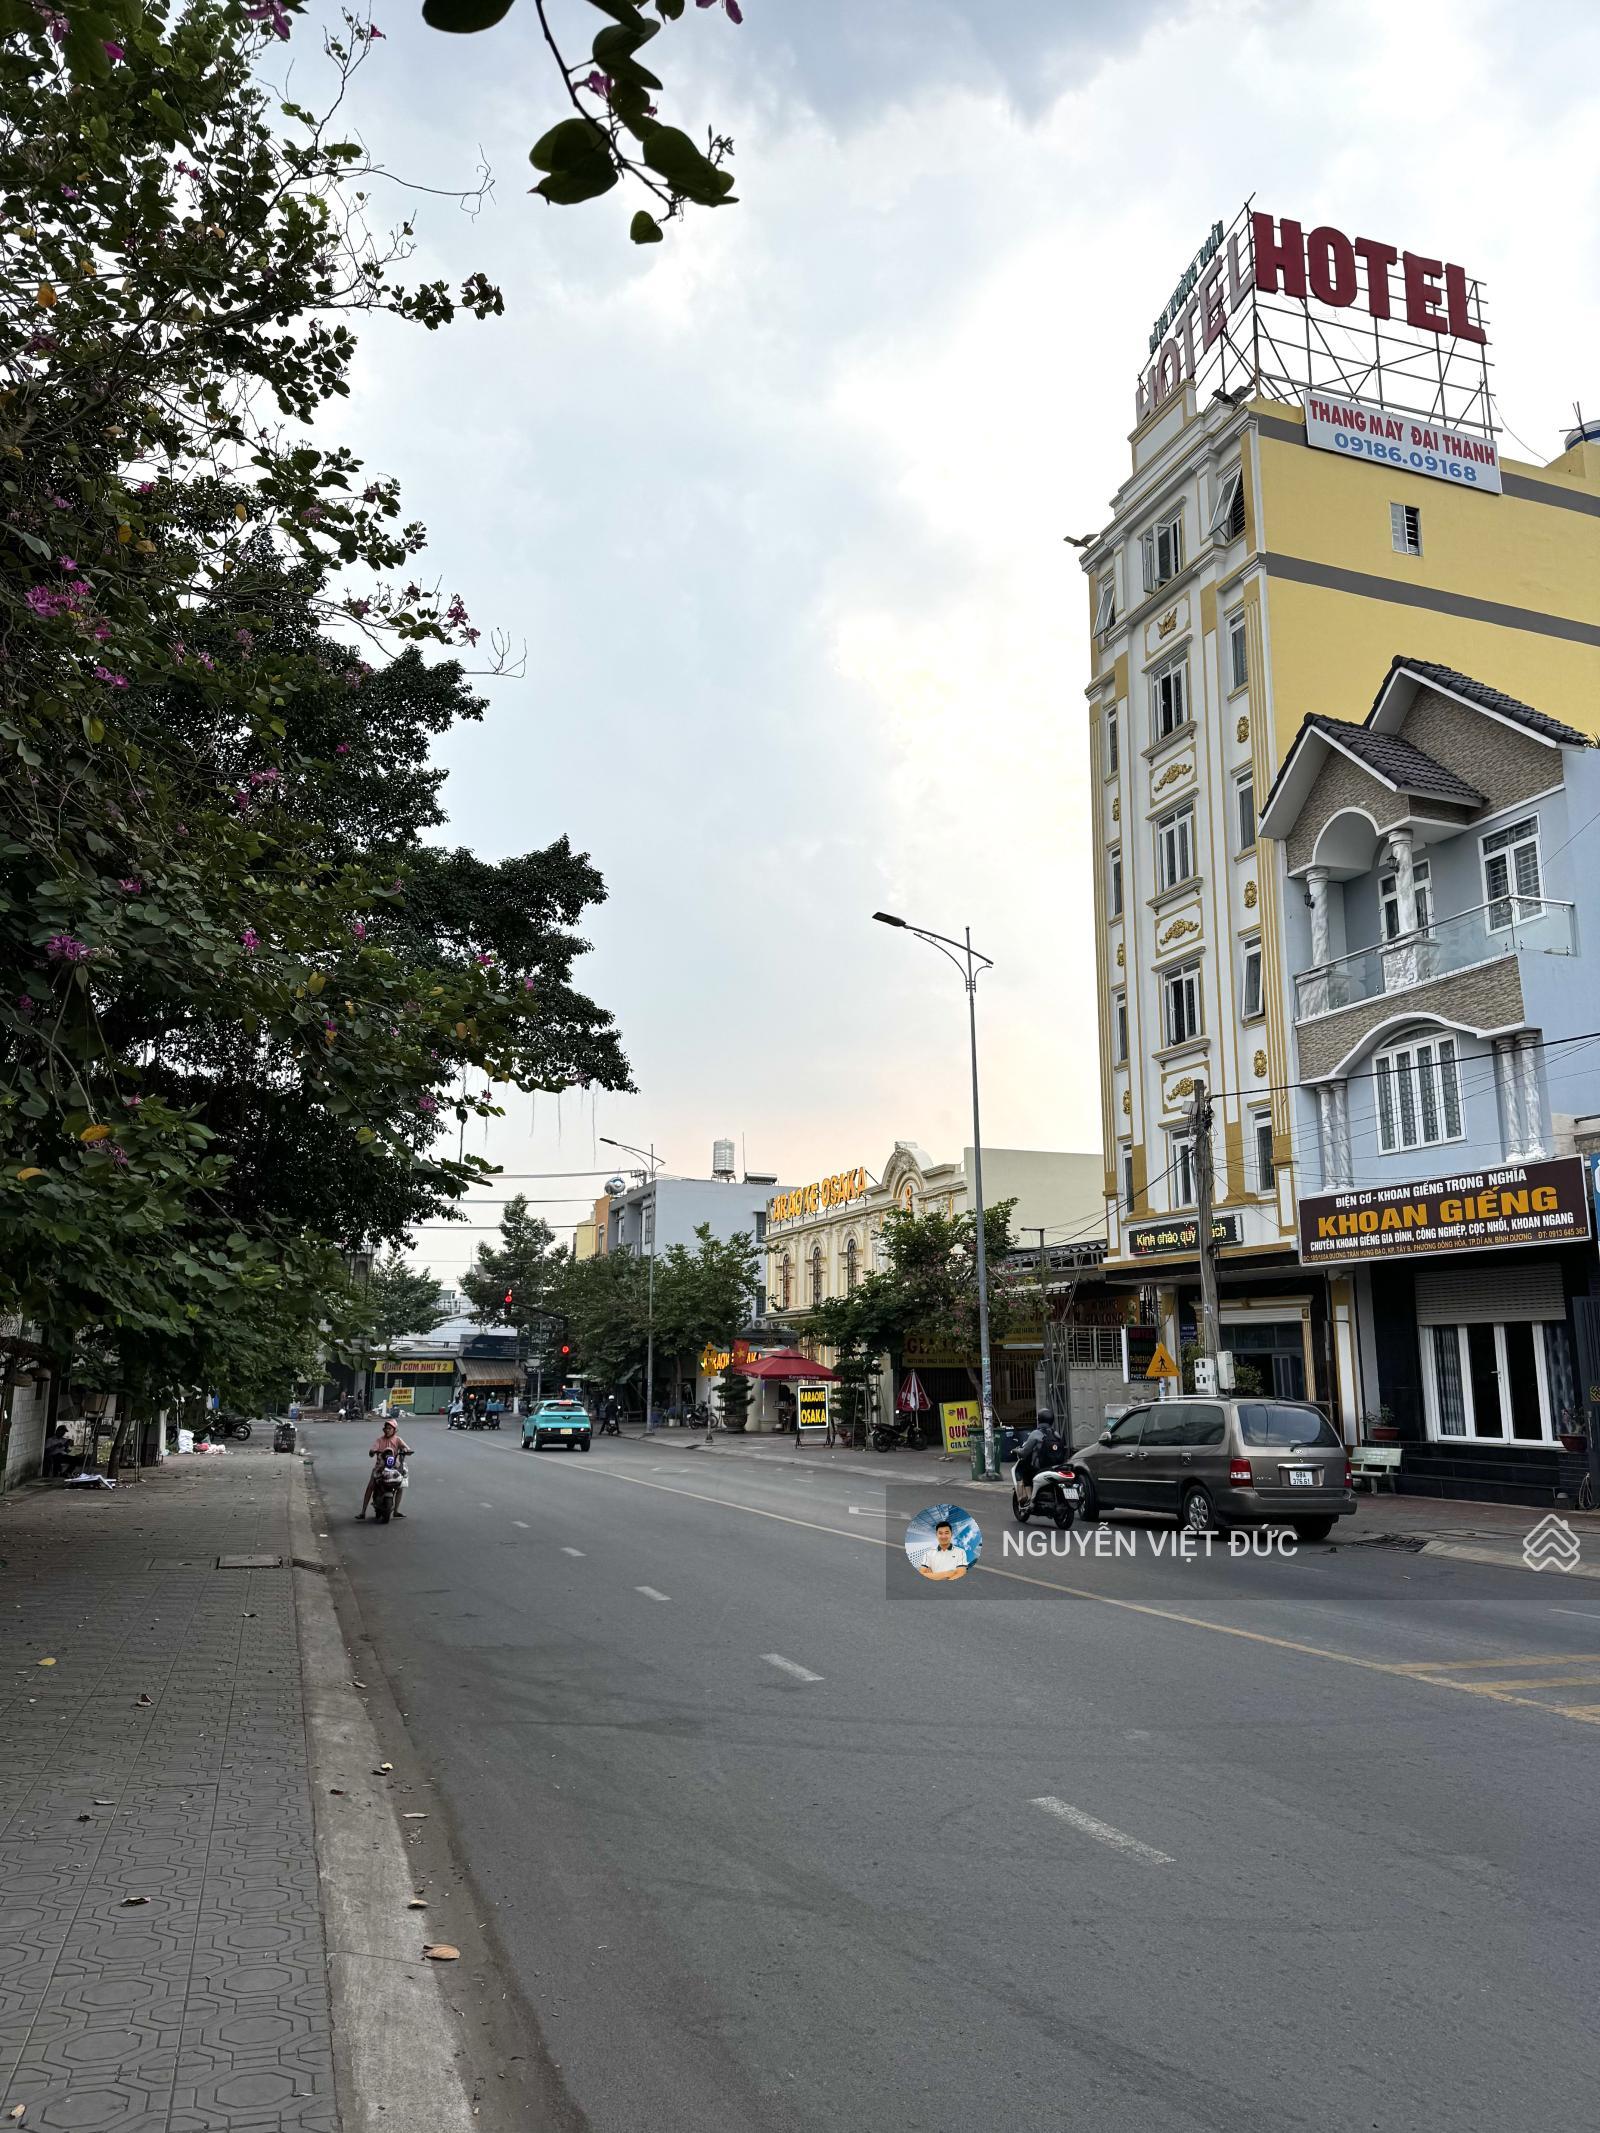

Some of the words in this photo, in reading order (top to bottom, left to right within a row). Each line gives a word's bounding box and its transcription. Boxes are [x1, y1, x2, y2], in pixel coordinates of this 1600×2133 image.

[1252, 211, 1487, 346] HOTEL
[1136, 232, 1256, 420] HOTEL
[1309, 399, 1366, 432] THANG
[1370, 415, 1404, 442] MÁY
[1411, 425, 1439, 454] ĐẠI
[1442, 434, 1496, 466] THÀNH
[1334, 432, 1477, 482] 09186.09168
[766, 1182, 819, 1223] KARAOKE
[821, 1166, 866, 1207] OSAKA
[1318, 1203, 1428, 1238] KHOAN
[1439, 1186, 1558, 1223] GIẾNG
[1335, 1194, 1357, 1208] ĐIỆN
[1359, 1191, 1372, 1205] CƠ
[1377, 1188, 1411, 1203] KHOAN
[1412, 1180, 1444, 1196] GIẾNG
[1445, 1175, 1484, 1192] TRỌNG
[1488, 1168, 1527, 1186] NGHĨA
[1336, 1236, 1359, 1249] KHOAN
[1359, 1232, 1380, 1246] GIẾNG
[1381, 1233, 1393, 1245] GIA
[1416, 1227, 1437, 1240] CÔNG
[1438, 1223, 1468, 1239] NGHIỆP,
[1468, 1222, 1485, 1237] CỌC
[1511, 1216, 1541, 1230] KHOAN
[1542, 1212, 1574, 1227] NGANG
[800, 1391, 826, 1402] KARAOKE
[800, 1408, 826, 1424] OSAKA
